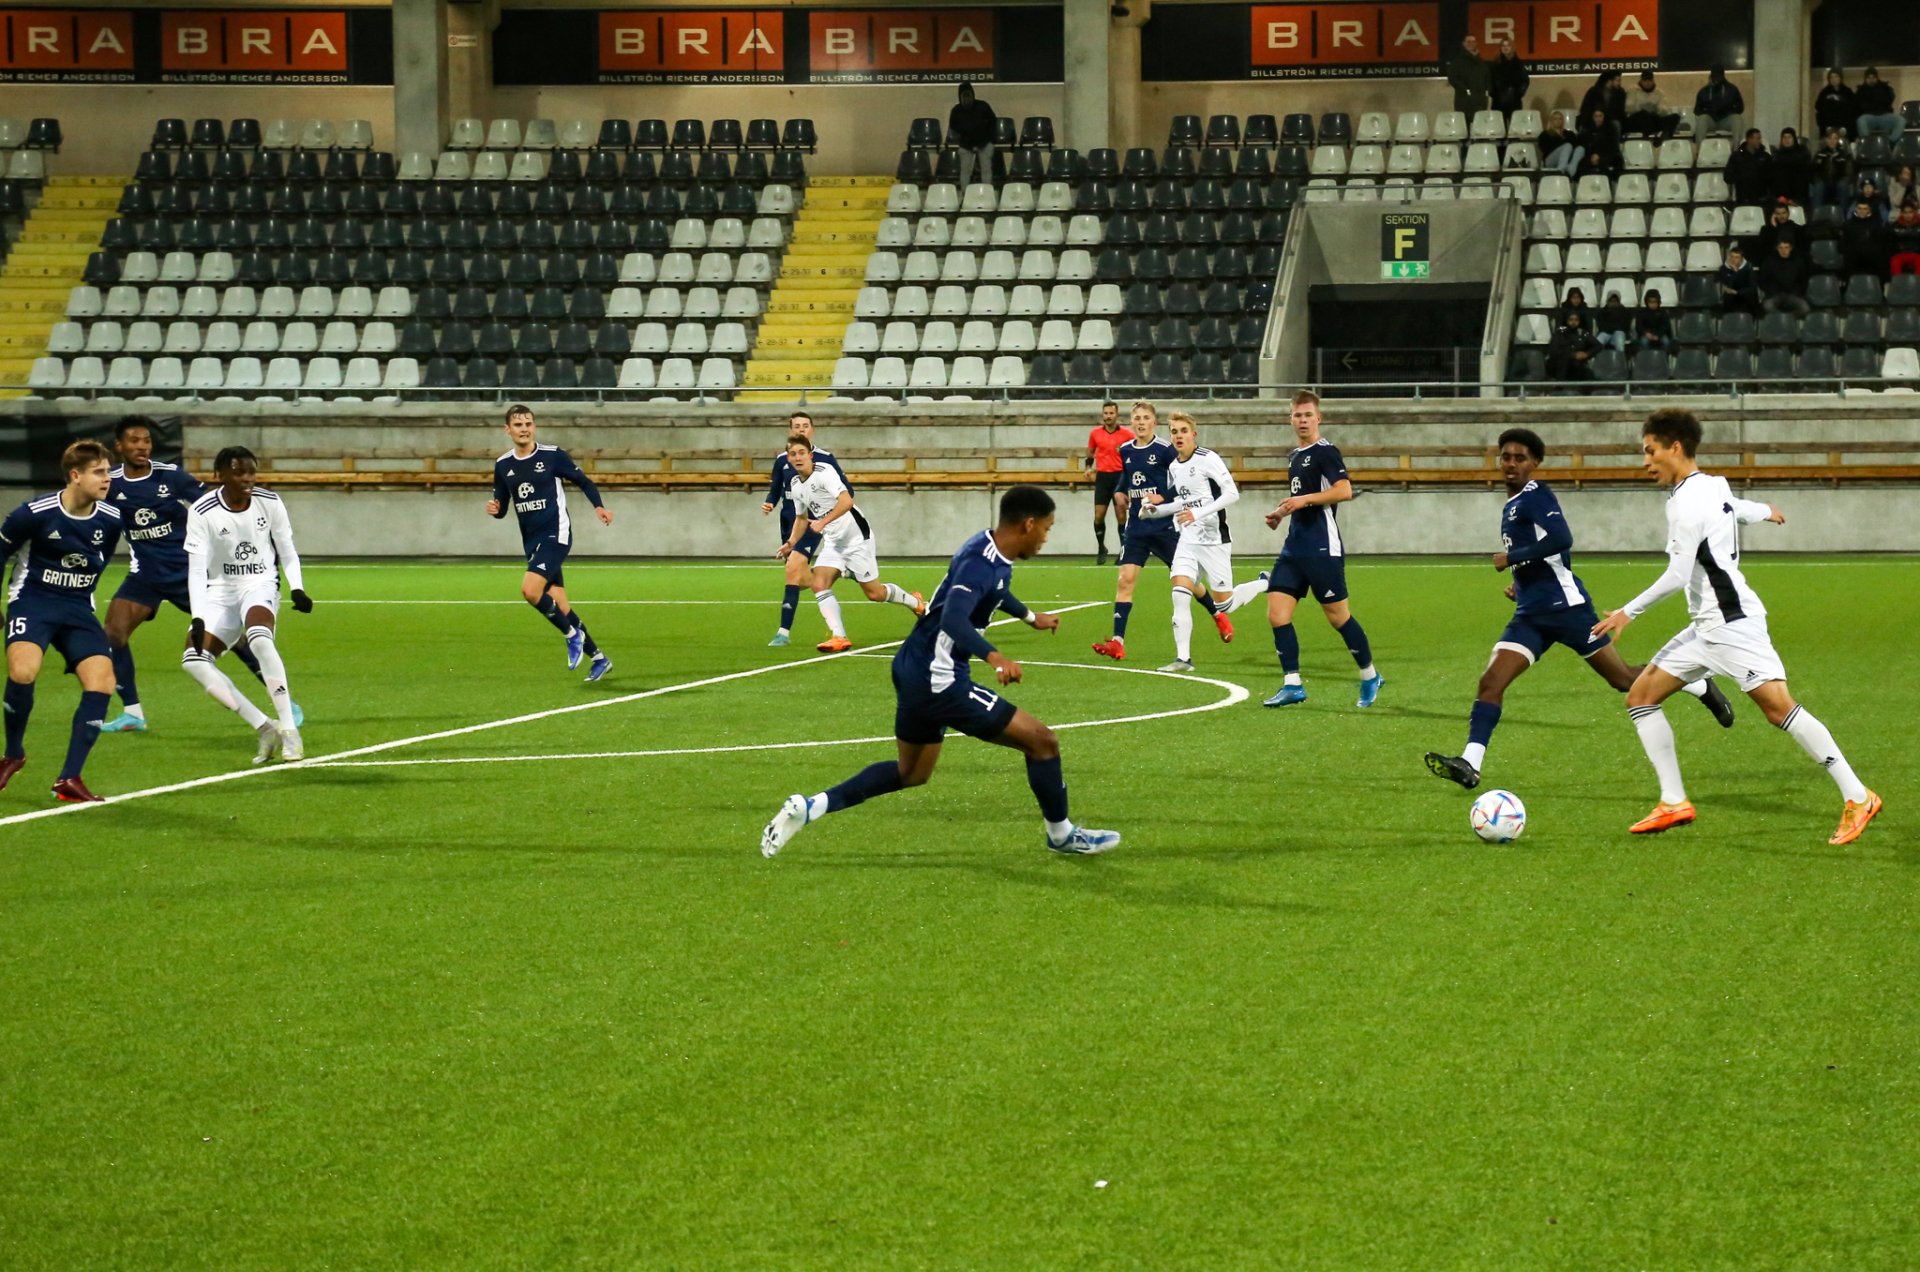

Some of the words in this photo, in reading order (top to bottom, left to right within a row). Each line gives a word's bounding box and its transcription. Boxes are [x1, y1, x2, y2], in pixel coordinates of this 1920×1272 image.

[1251, 67, 1316, 77] BILLSTRÖM
[1320, 68, 1362, 76] RIEMER
[1366, 67, 1439, 75] ANDERSSON
[1536, 64, 1580, 72] RIEMER
[1583, 62, 1658, 70] ANDERSSON
[230, 74, 272, 82] RIEMER
[275, 74, 348, 82] ANDERSSON
[809, 73, 872, 82] BILLSTRÖM
[922, 73, 994, 81] ANDERSSON
[1385, 215, 1426, 225] SEKTION
[1395, 228, 1416, 259] F
[129, 521, 173, 540] GRITNEST
[42, 568, 97, 588] GRITNEST
[7, 616, 27, 639] 15
[968, 685, 999, 712] 11
